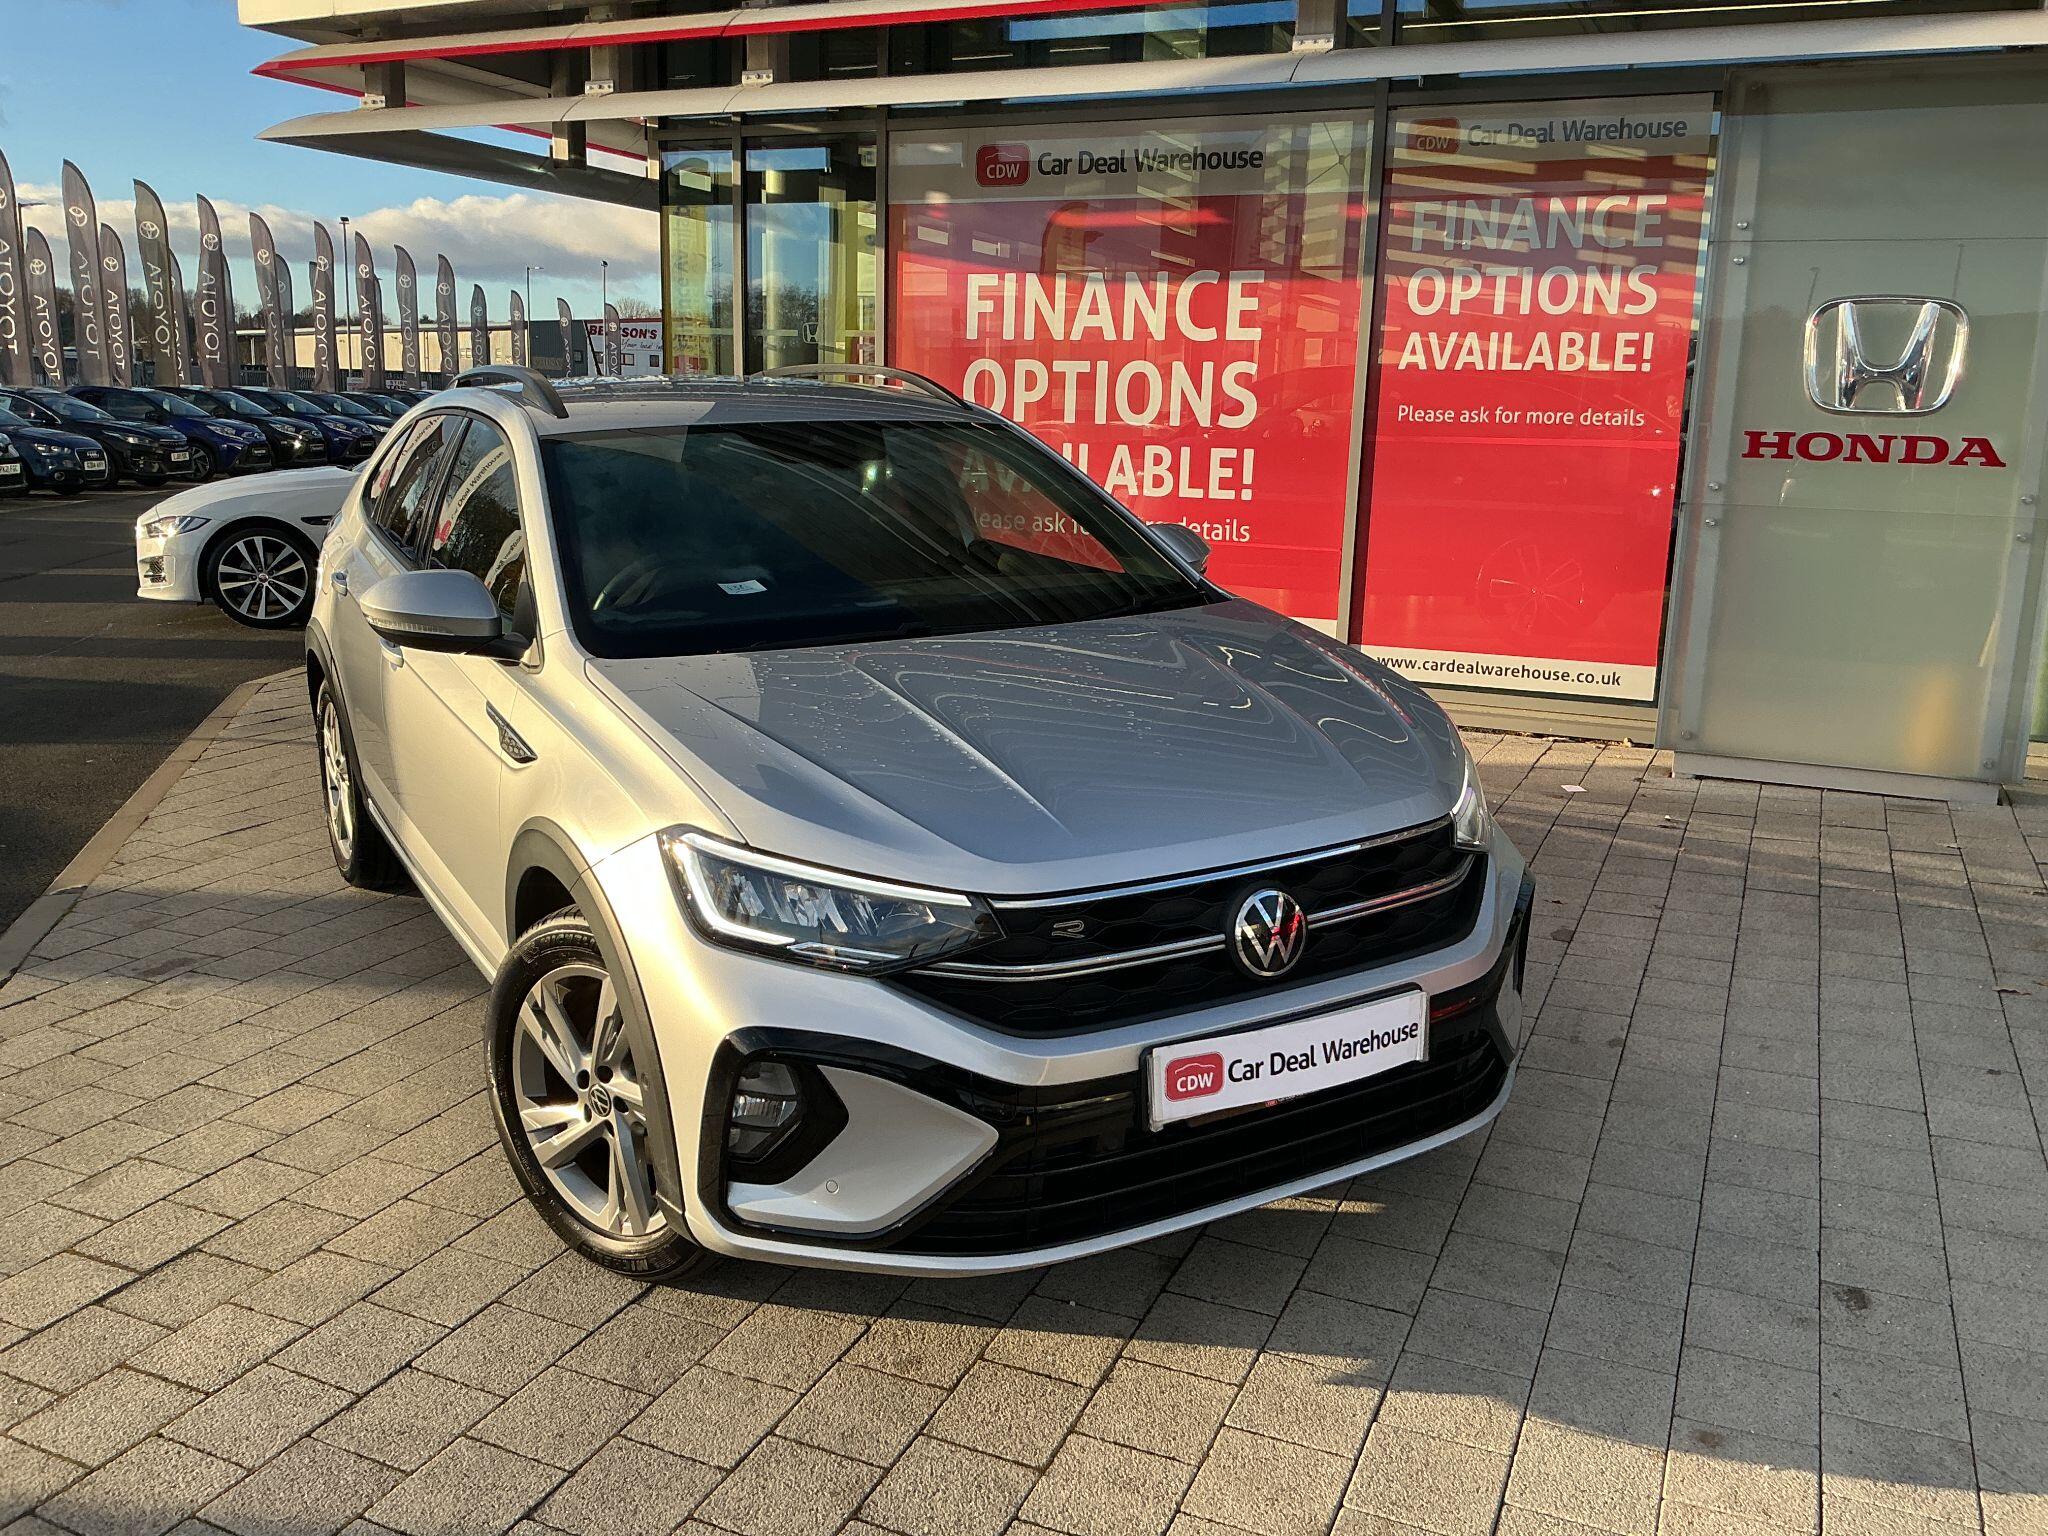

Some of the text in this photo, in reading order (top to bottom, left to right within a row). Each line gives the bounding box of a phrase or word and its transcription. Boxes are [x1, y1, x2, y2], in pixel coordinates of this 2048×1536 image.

[1417, 138, 1449, 151] CDW
[1467, 116, 1688, 147] Car Deal Warehouse
[986, 163, 1020, 179] CDW
[1037, 146, 1264, 175] Car Deal Warehouse
[1411, 194, 1668, 251] FINANCE
[966, 269, 1265, 341] FINANCE
[1407, 265, 1658, 316] OPTIONS
[1397, 331, 1655, 372] AVAILABLE!
[963, 358, 1258, 429] OPTIONS
[1398, 404, 1645, 427] Please ask for more details
[1741, 430, 2007, 467] HONDA
[1031, 512, 1067, 534] ask
[1182, 516, 1250, 542] etails
[1376, 656, 1622, 687] www.cardealwarehouse.co.uk
[1228, 1021, 1419, 1083] Car Deal Warehouse
[1176, 1071, 1214, 1092] CDW
